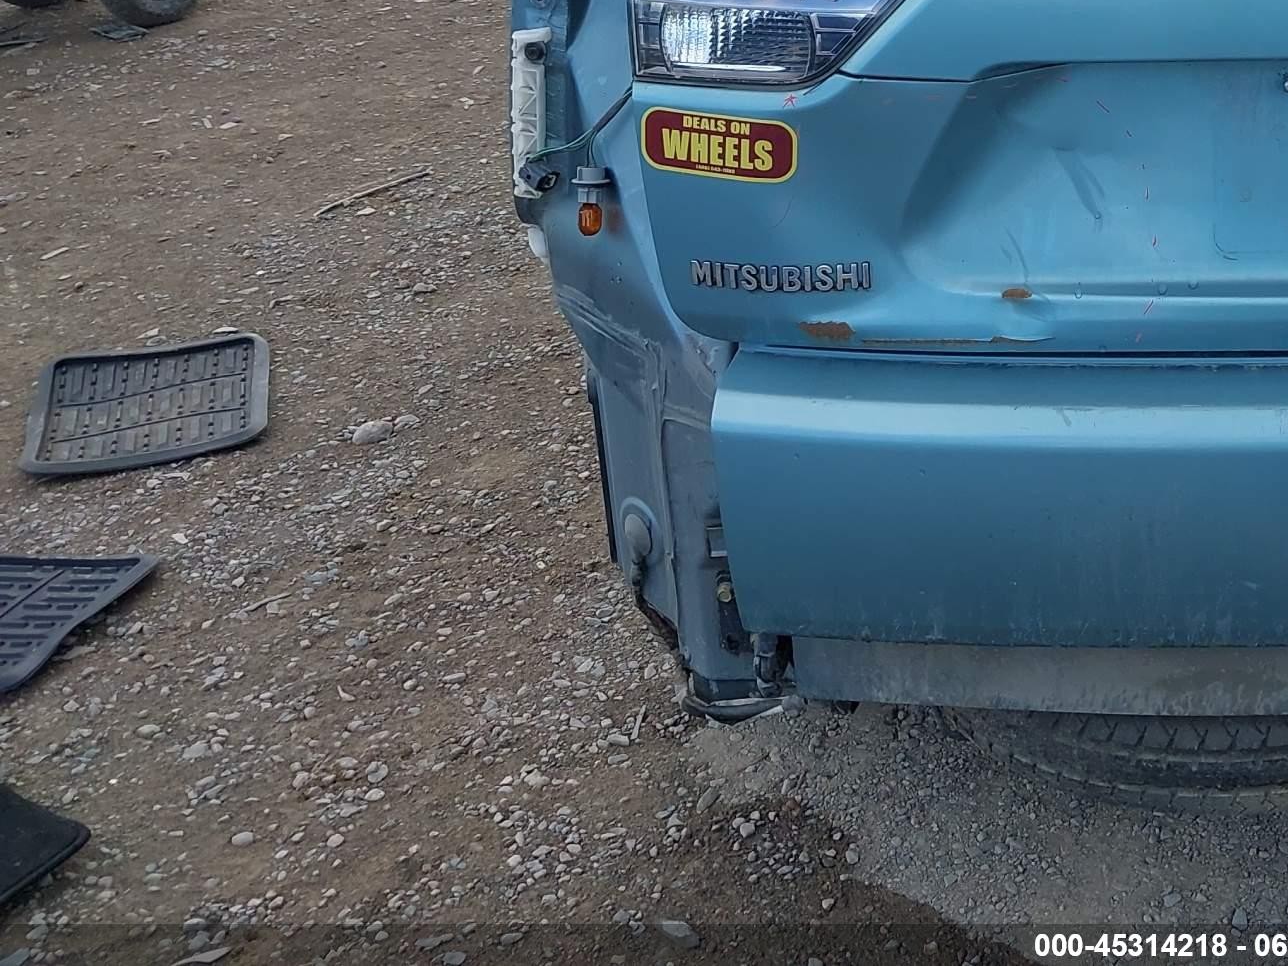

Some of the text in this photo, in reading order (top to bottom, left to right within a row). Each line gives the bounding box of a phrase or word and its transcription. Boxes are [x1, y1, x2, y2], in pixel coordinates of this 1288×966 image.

[682, 115, 751, 135] DEALS ON
[661, 128, 773, 171] WHEELS
[690, 259, 872, 293] MITSUBISHI
